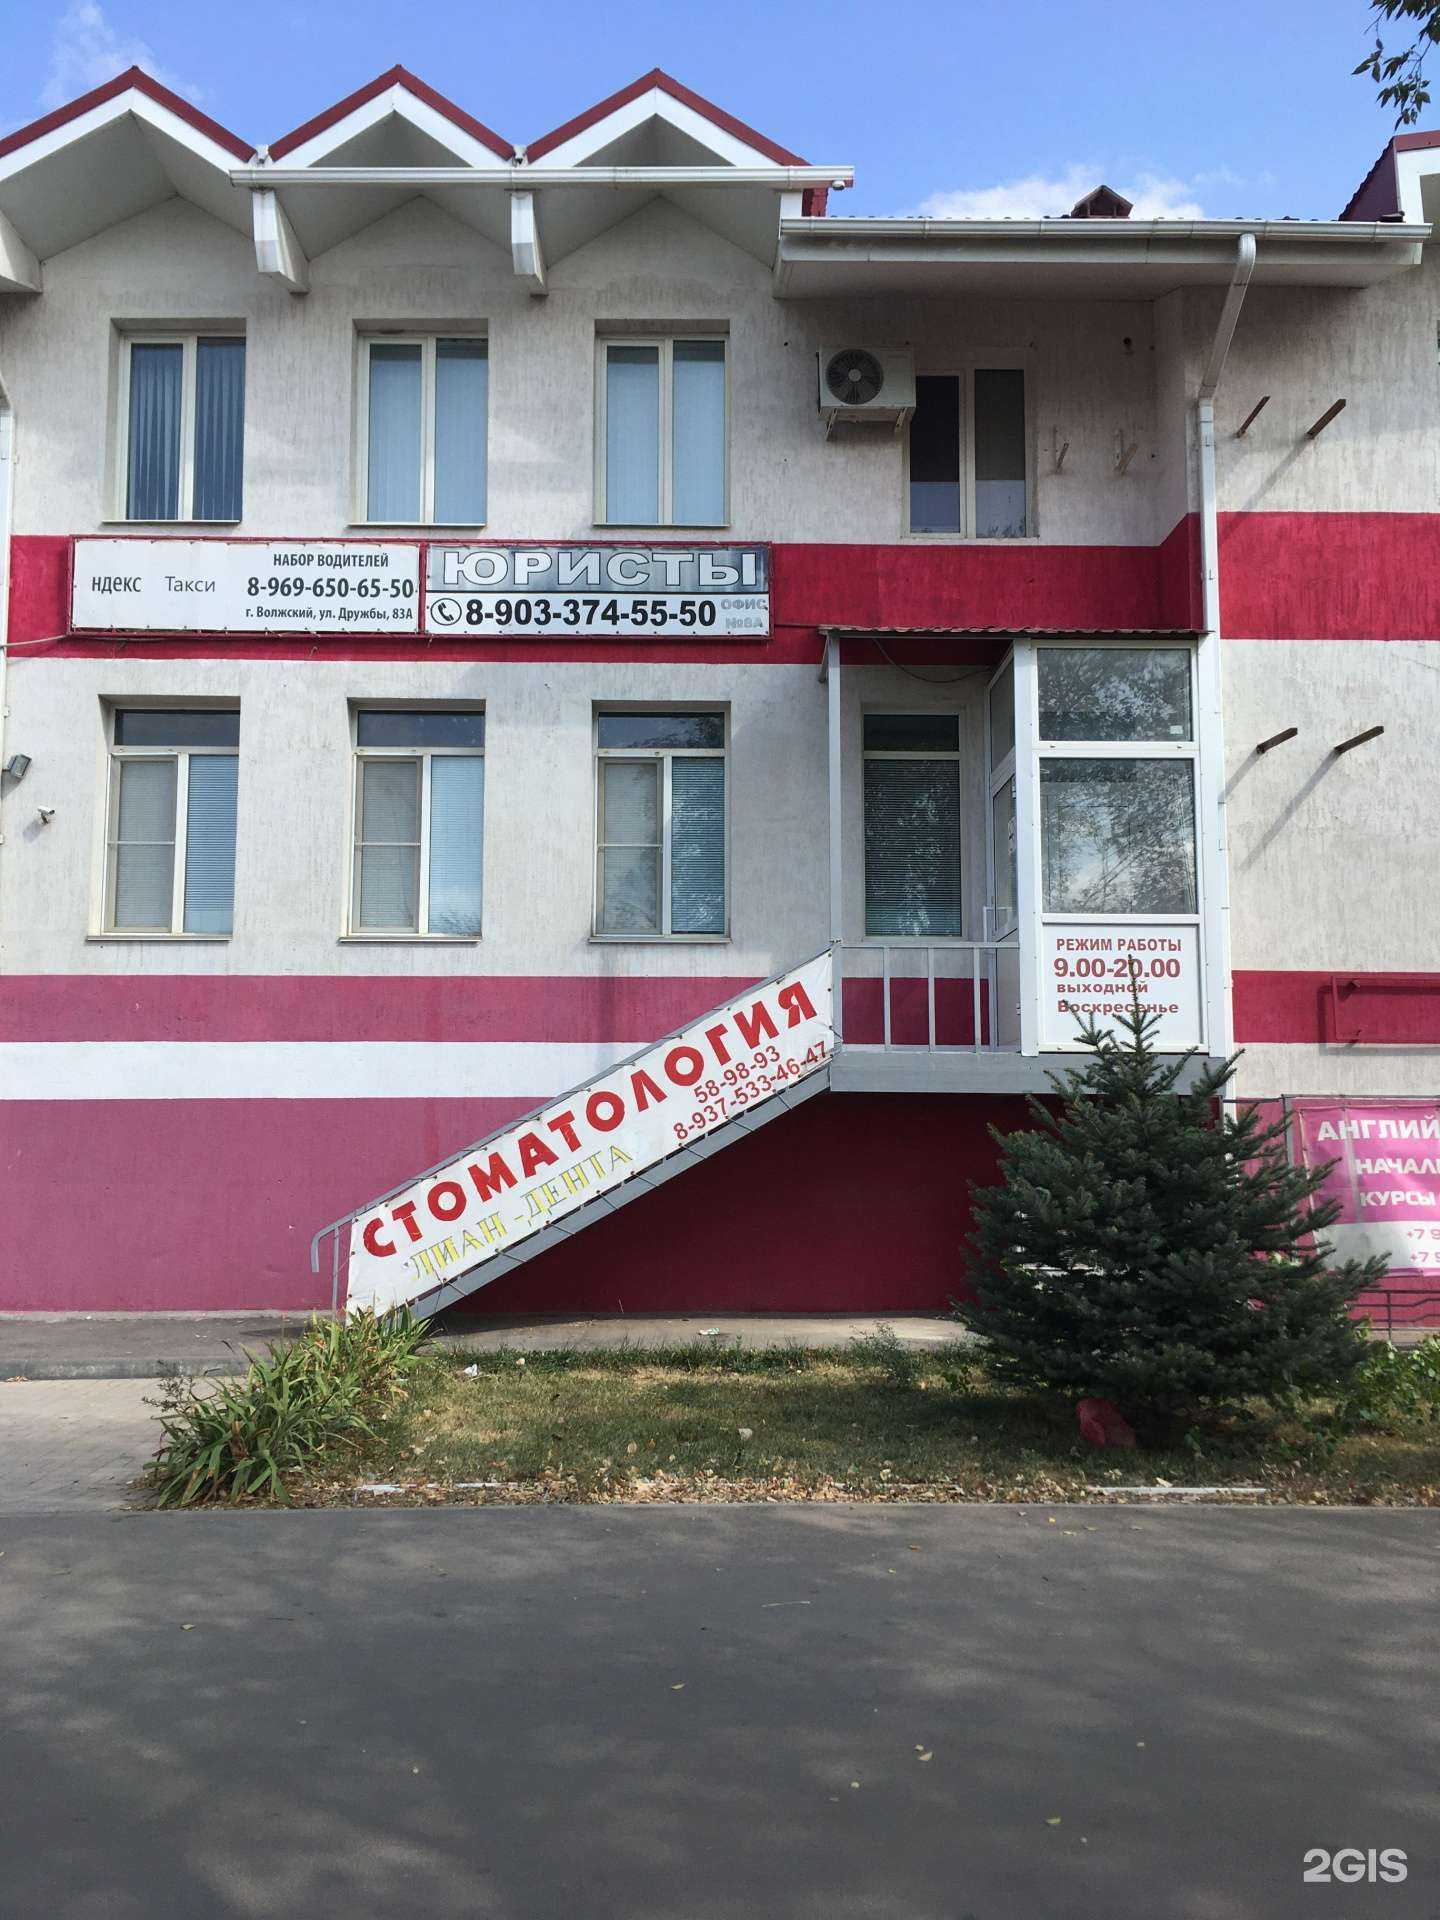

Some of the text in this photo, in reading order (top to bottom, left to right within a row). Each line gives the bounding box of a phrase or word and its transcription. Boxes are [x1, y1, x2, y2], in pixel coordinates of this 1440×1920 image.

[273, 552, 389, 569] НАБОР ВОДИТЕЛЕЙ
[442, 550, 757, 587] ЮРИСТЫ
[164, 576, 216, 593] Такси
[246, 577, 414, 599] 8-969-650-65-50
[720, 598, 766, 610] ОФИС
[245, 608, 253, 618] г.
[256, 606, 317, 620] Волжский,
[319, 609, 336, 621] ул.
[338, 607, 390, 622] Дружбы,
[465, 599, 716, 627] 8-903-374-55-50
[1056, 938, 1182, 952] РЕЖИМ РАБОТЫ
[1053, 957, 1181, 979] 9.00-20.00
[1056, 981, 1149, 995] выходной
[1057, 999, 1180, 1016] Воскресенье
[693, 1044, 782, 1105] 58-98-93
[673, 1040, 829, 1141] 8-937-533-46-47
[362, 980, 818, 1258] СТОМАТОЛОГИЯ
[1359, 1191, 1436, 1208] КУРСЫ
